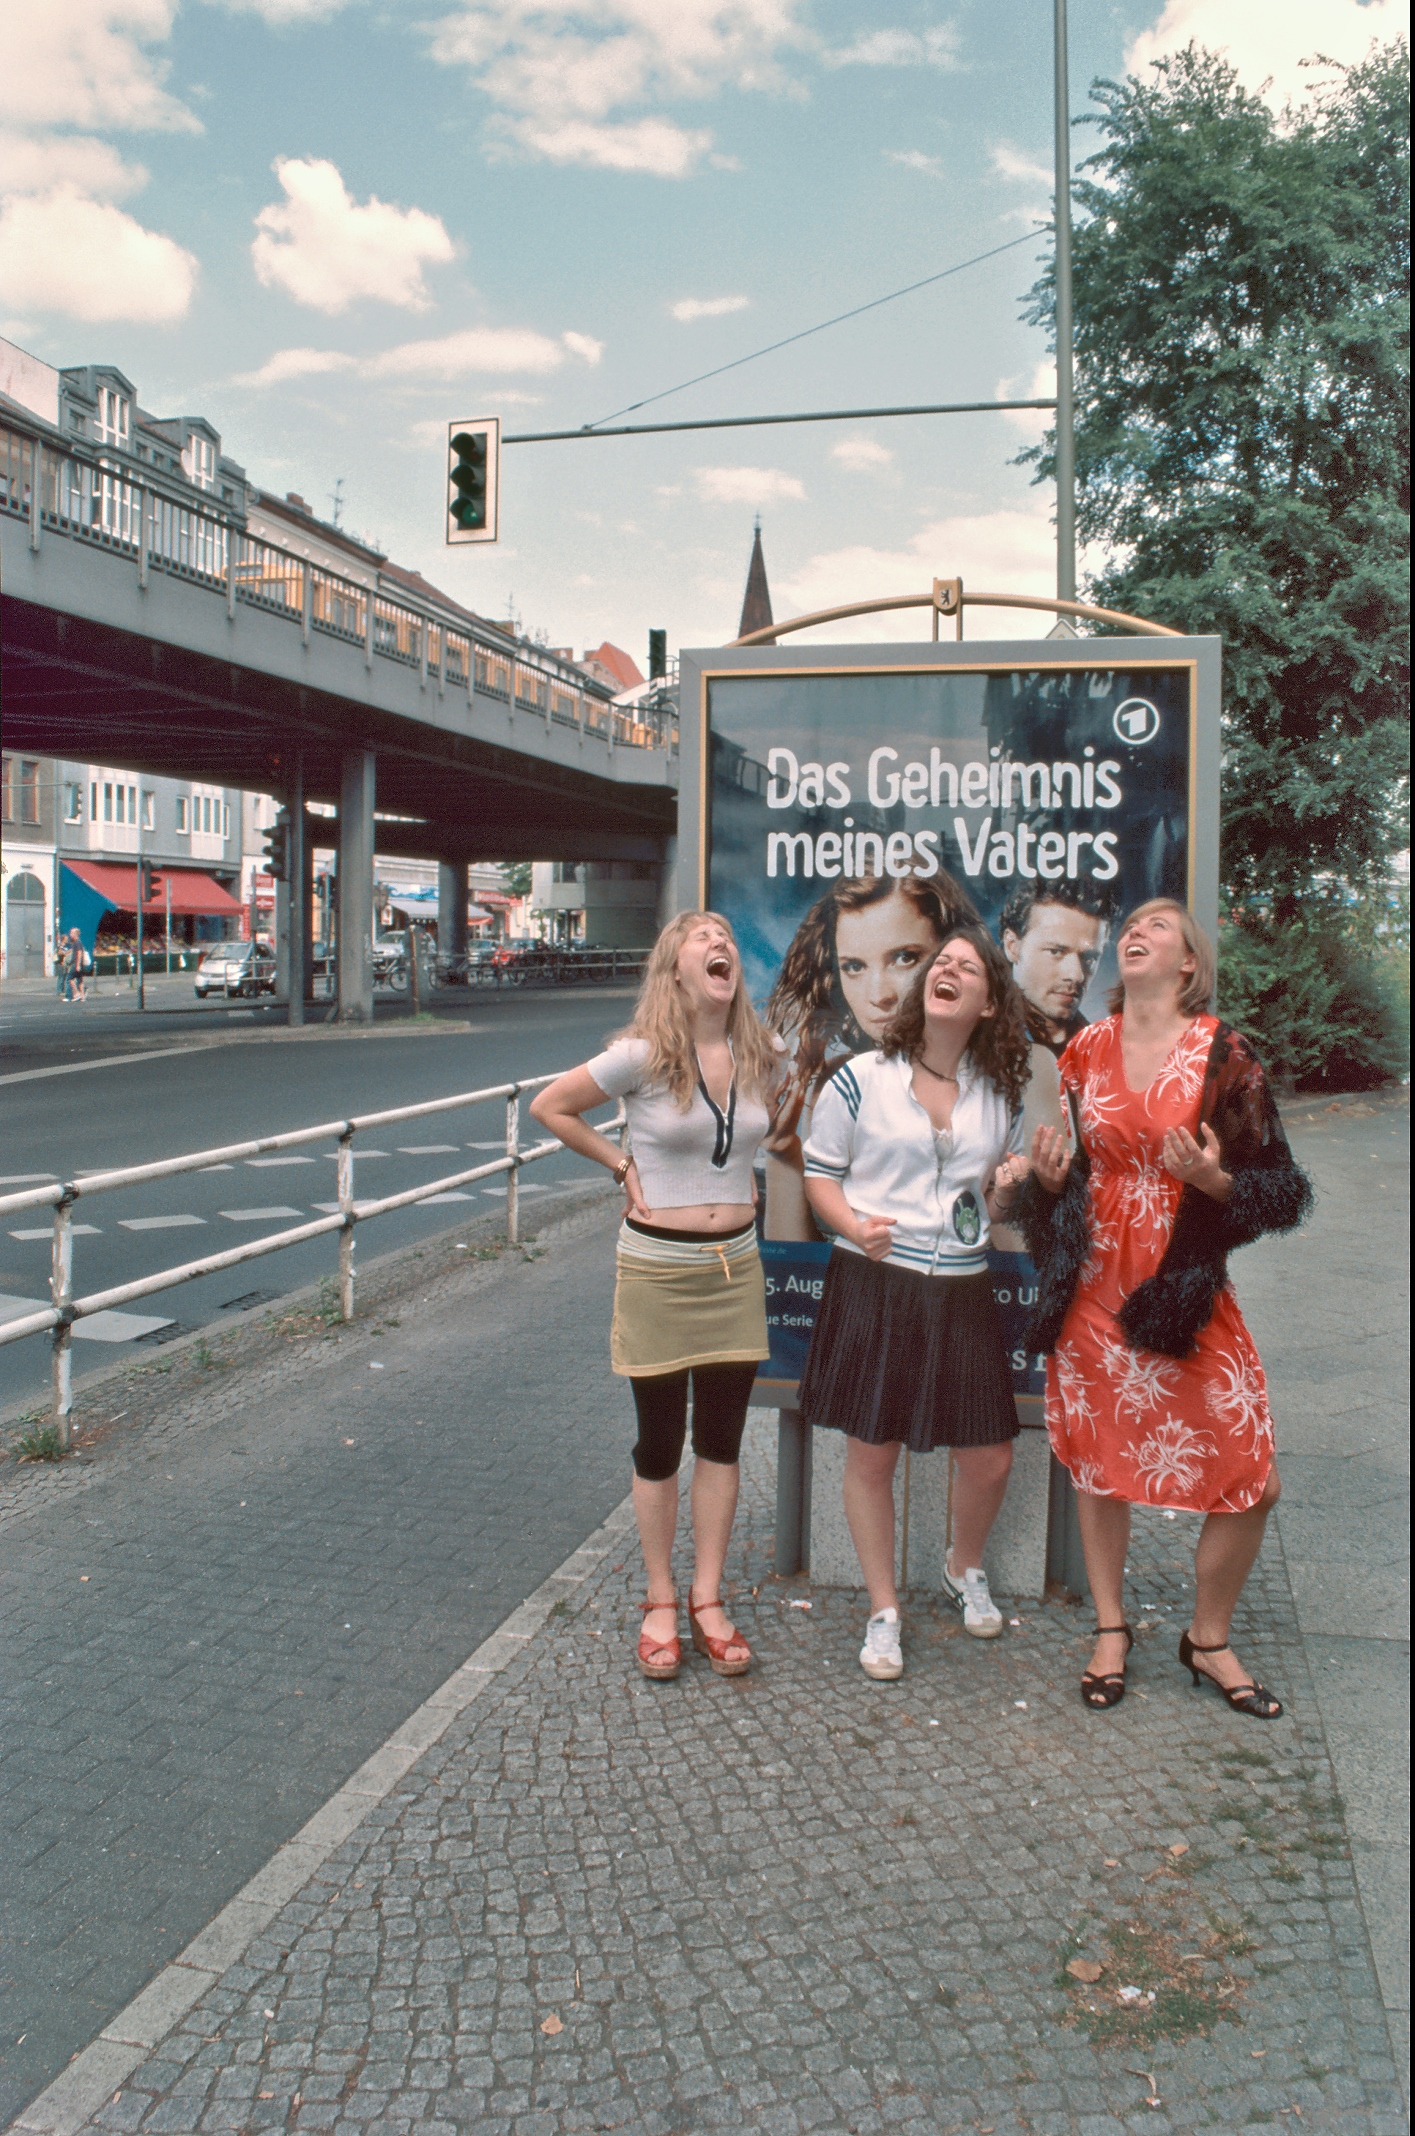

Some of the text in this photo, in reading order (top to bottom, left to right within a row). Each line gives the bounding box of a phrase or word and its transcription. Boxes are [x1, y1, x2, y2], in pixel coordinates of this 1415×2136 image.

[767, 745, 1122, 809] Das Geheimnis
[767, 816, 1120, 881] meines Vaters
[784, 1274, 825, 1300] Aug
[782, 1313, 814, 1327] Serie
